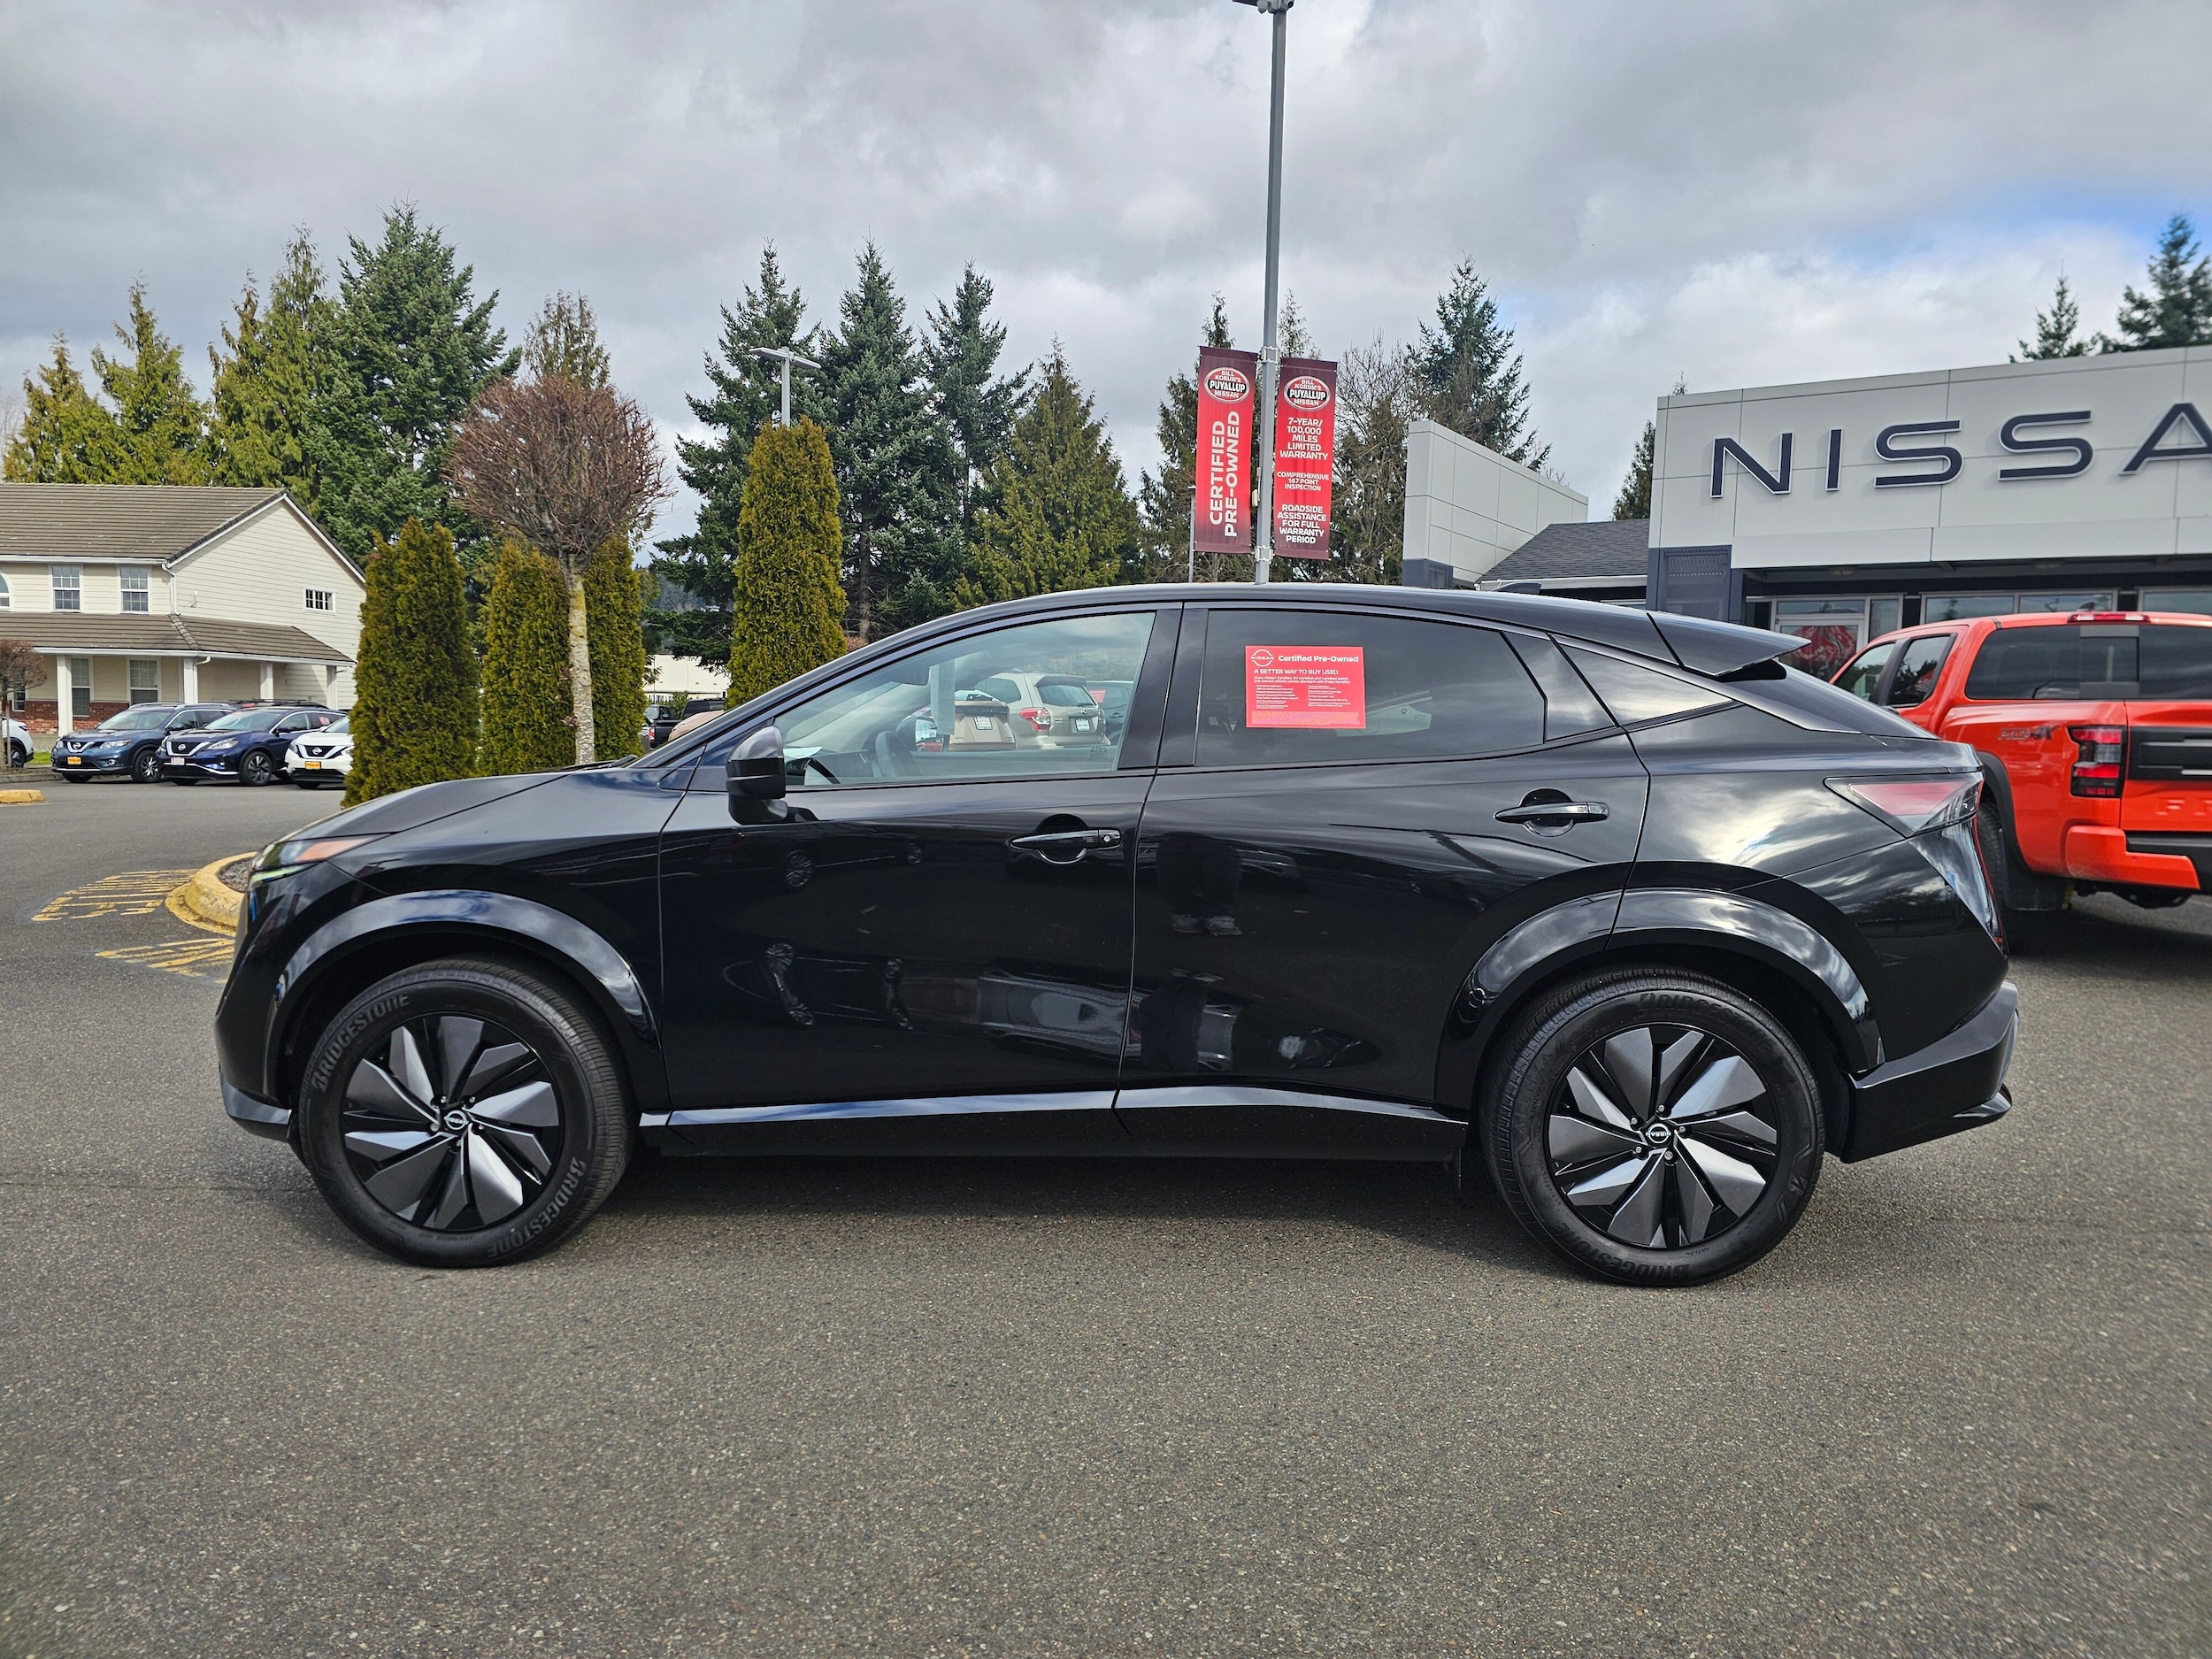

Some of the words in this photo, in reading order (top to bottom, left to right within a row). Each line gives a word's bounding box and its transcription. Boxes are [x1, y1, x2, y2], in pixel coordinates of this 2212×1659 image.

[1210, 380, 1245, 392] PUYALLUP
[1289, 389, 1325, 400] PUYALLUP
[1288, 418, 1323, 427] 7-YEAR/
[1286, 426, 1321, 434] 100,000
[1287, 442, 1321, 451] LIMITED
[1710, 403, 2212, 498] NISSA
[1279, 450, 1328, 460] WARRANTY
[1210, 421, 1225, 525] CERTIFIED
[1225, 411, 1240, 537] PRE-OWNED
[1282, 504, 1323, 513] ROADSIDE
[1277, 512, 1326, 521] ASSISTANCE
[1279, 527, 1325, 537] WARRANTY
[1638, 992, 1775, 1050] BRIDGESTONE
[311, 994, 410, 1093] BRIDGESTONE
[488, 1155, 588, 1258] BRIDGESTONE
[1552, 1221, 1691, 1281] BRIDGESTONE
